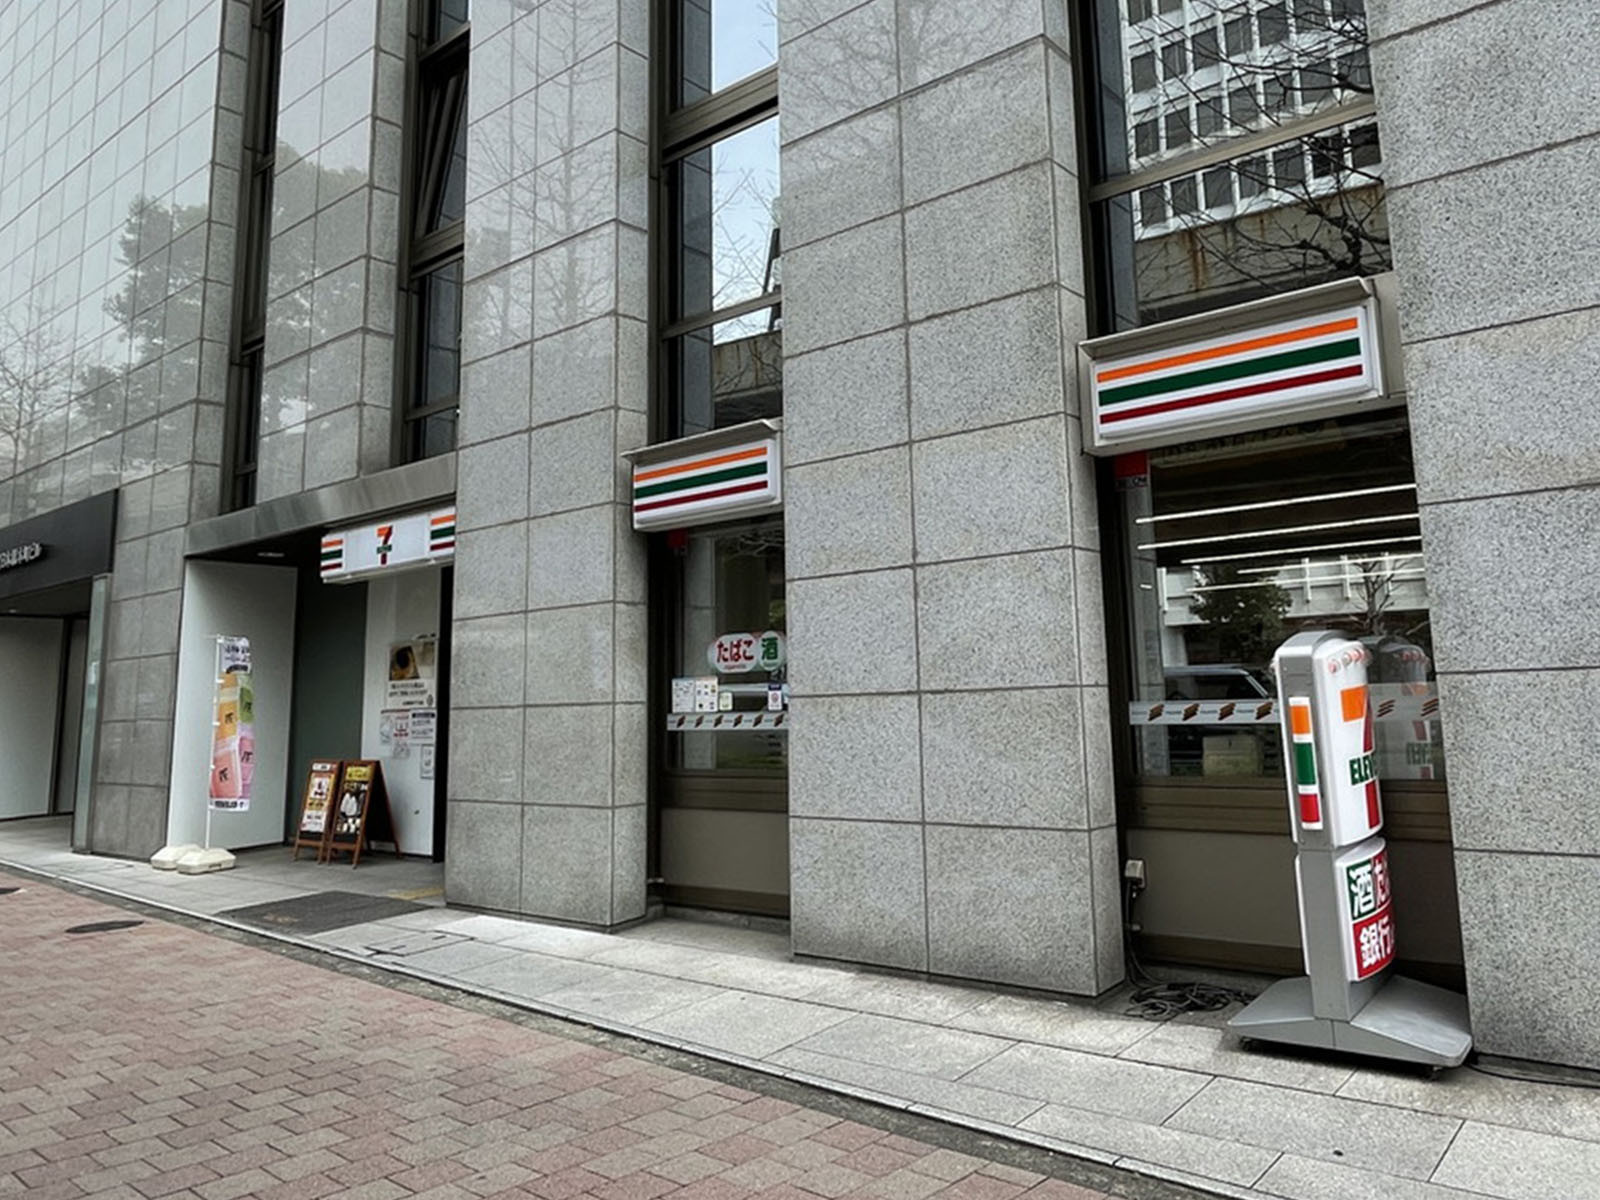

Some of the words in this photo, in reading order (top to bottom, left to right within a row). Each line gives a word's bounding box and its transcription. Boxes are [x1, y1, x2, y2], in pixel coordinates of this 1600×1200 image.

[717, 638, 754, 663] たばこ
[761, 637, 779, 661] 酒
[1349, 862, 1374, 917] 酒
[1360, 915, 1394, 968] 銀行
